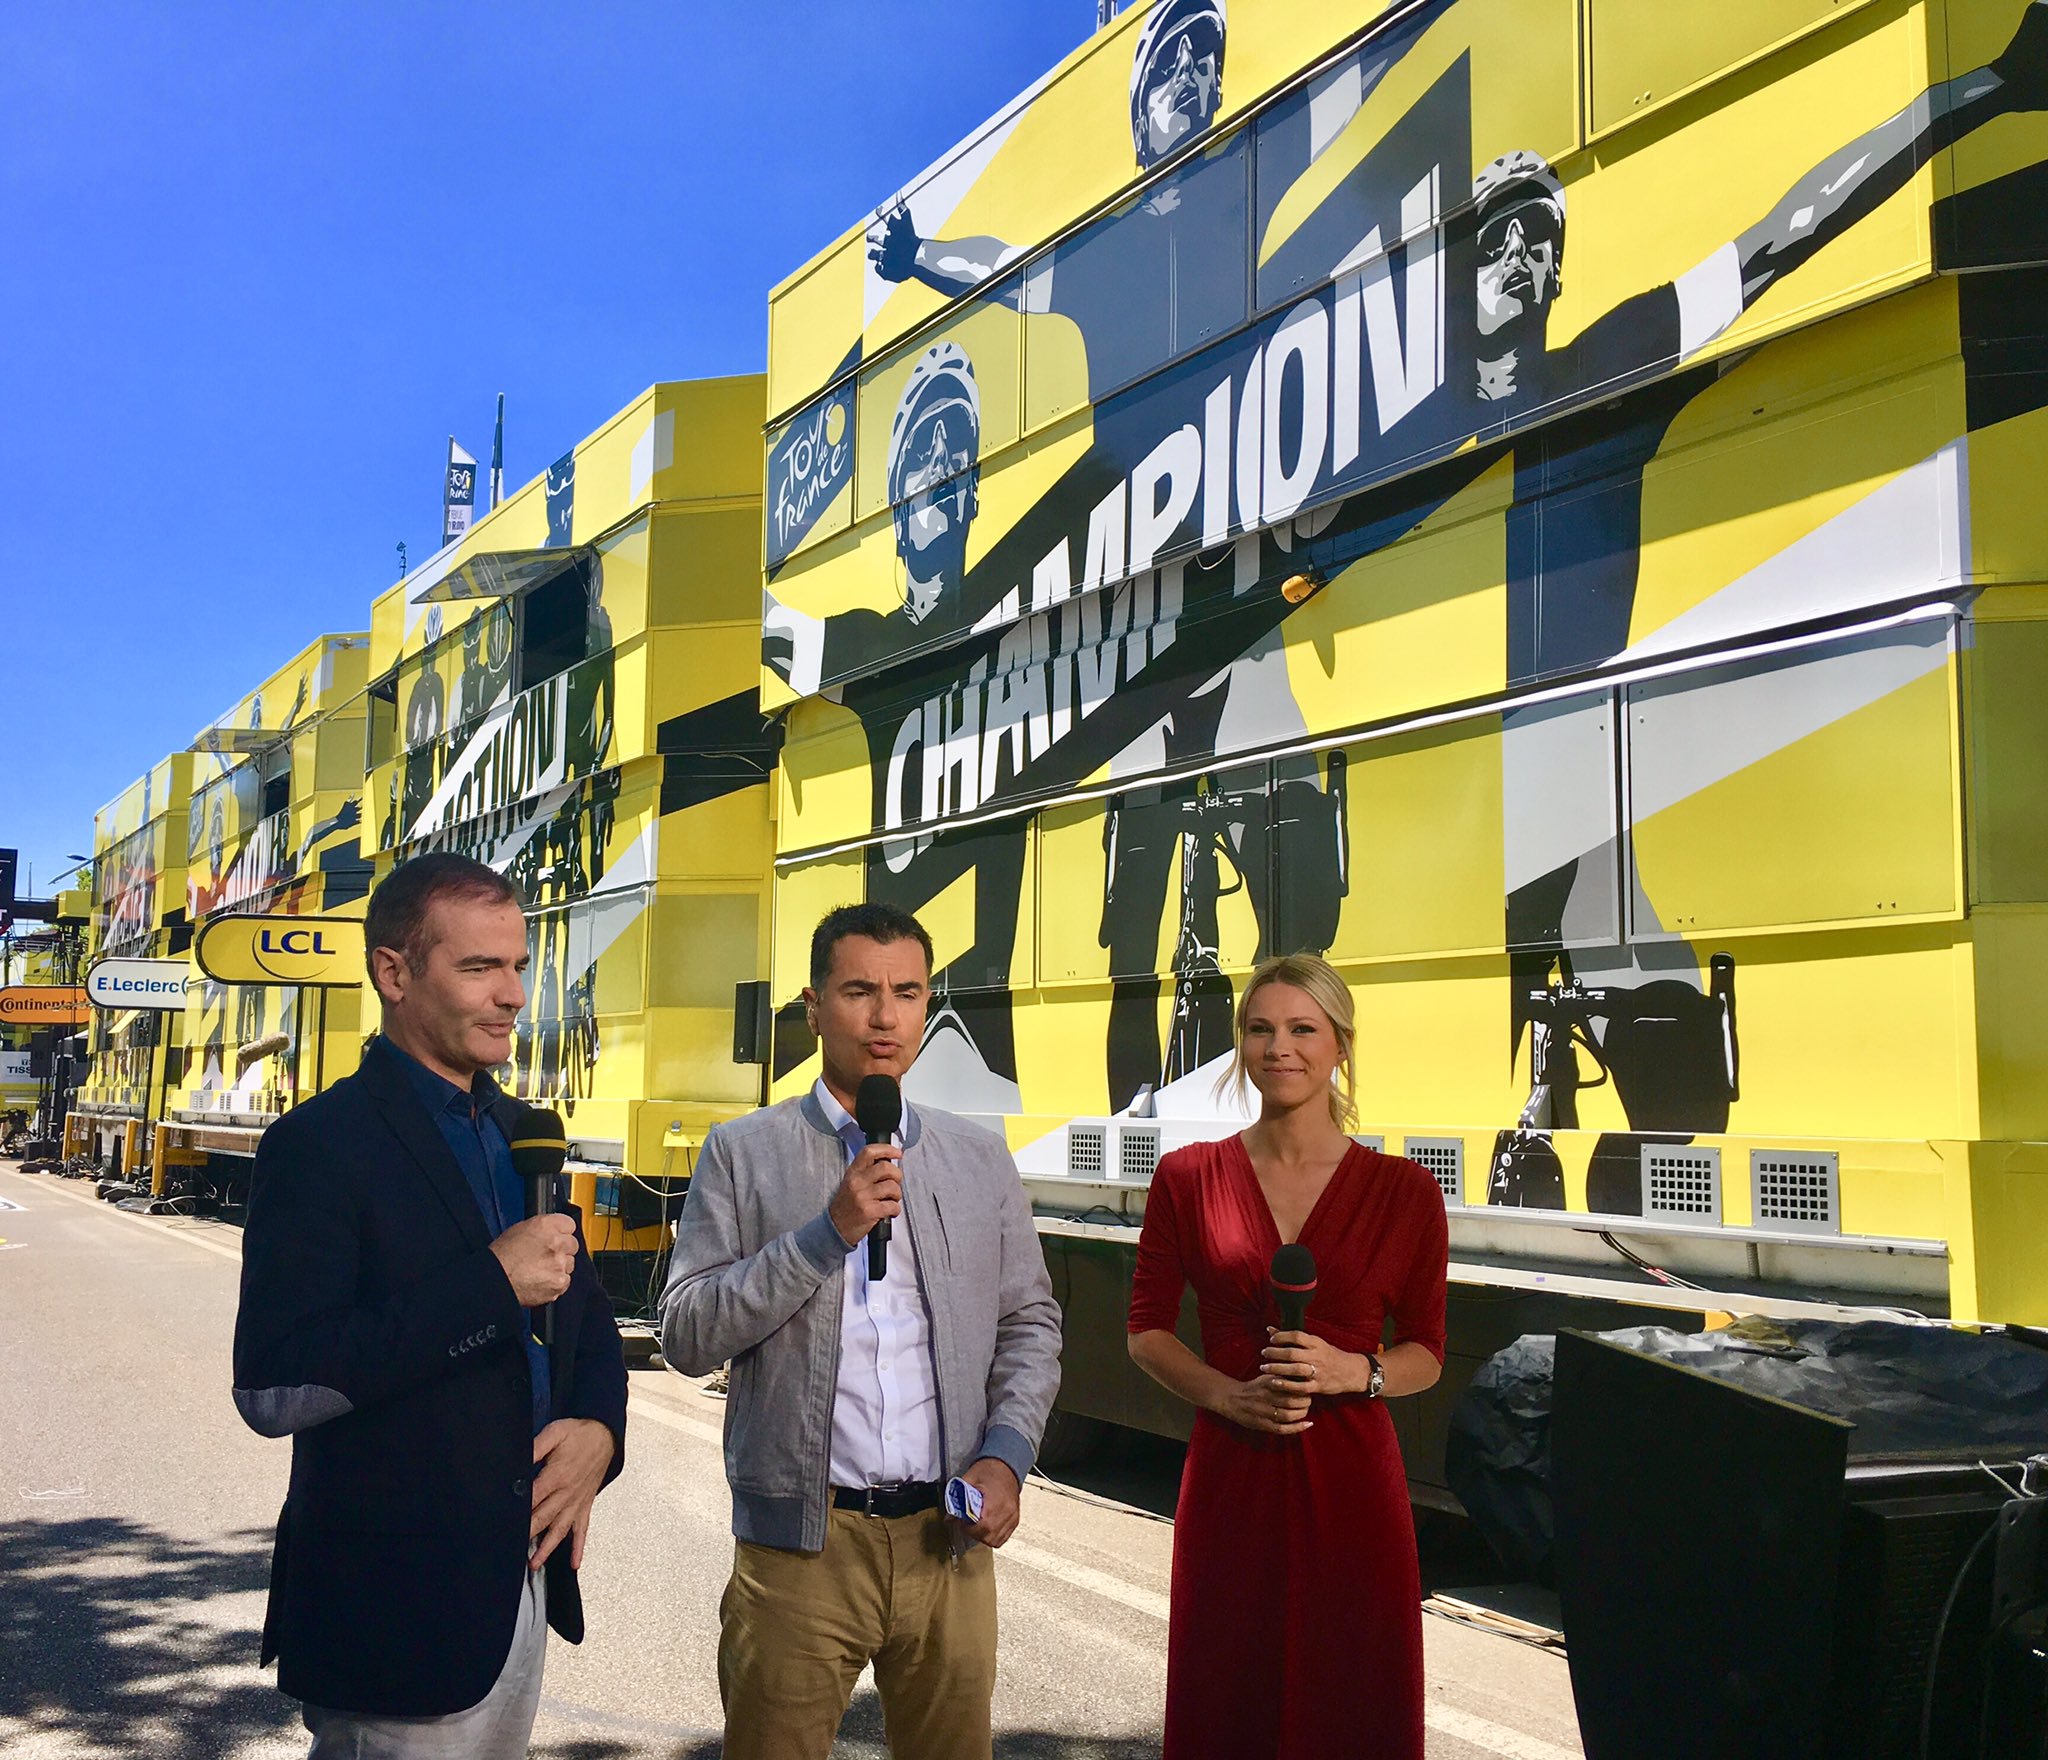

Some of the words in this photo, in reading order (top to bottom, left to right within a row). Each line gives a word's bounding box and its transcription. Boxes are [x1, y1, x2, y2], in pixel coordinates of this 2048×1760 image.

[883, 163, 1445, 873] CHAMPION
[261, 930, 336, 955] LCL
[97, 977, 179, 993] E.Leclerc
[6, 1066, 31, 1074] TISS
